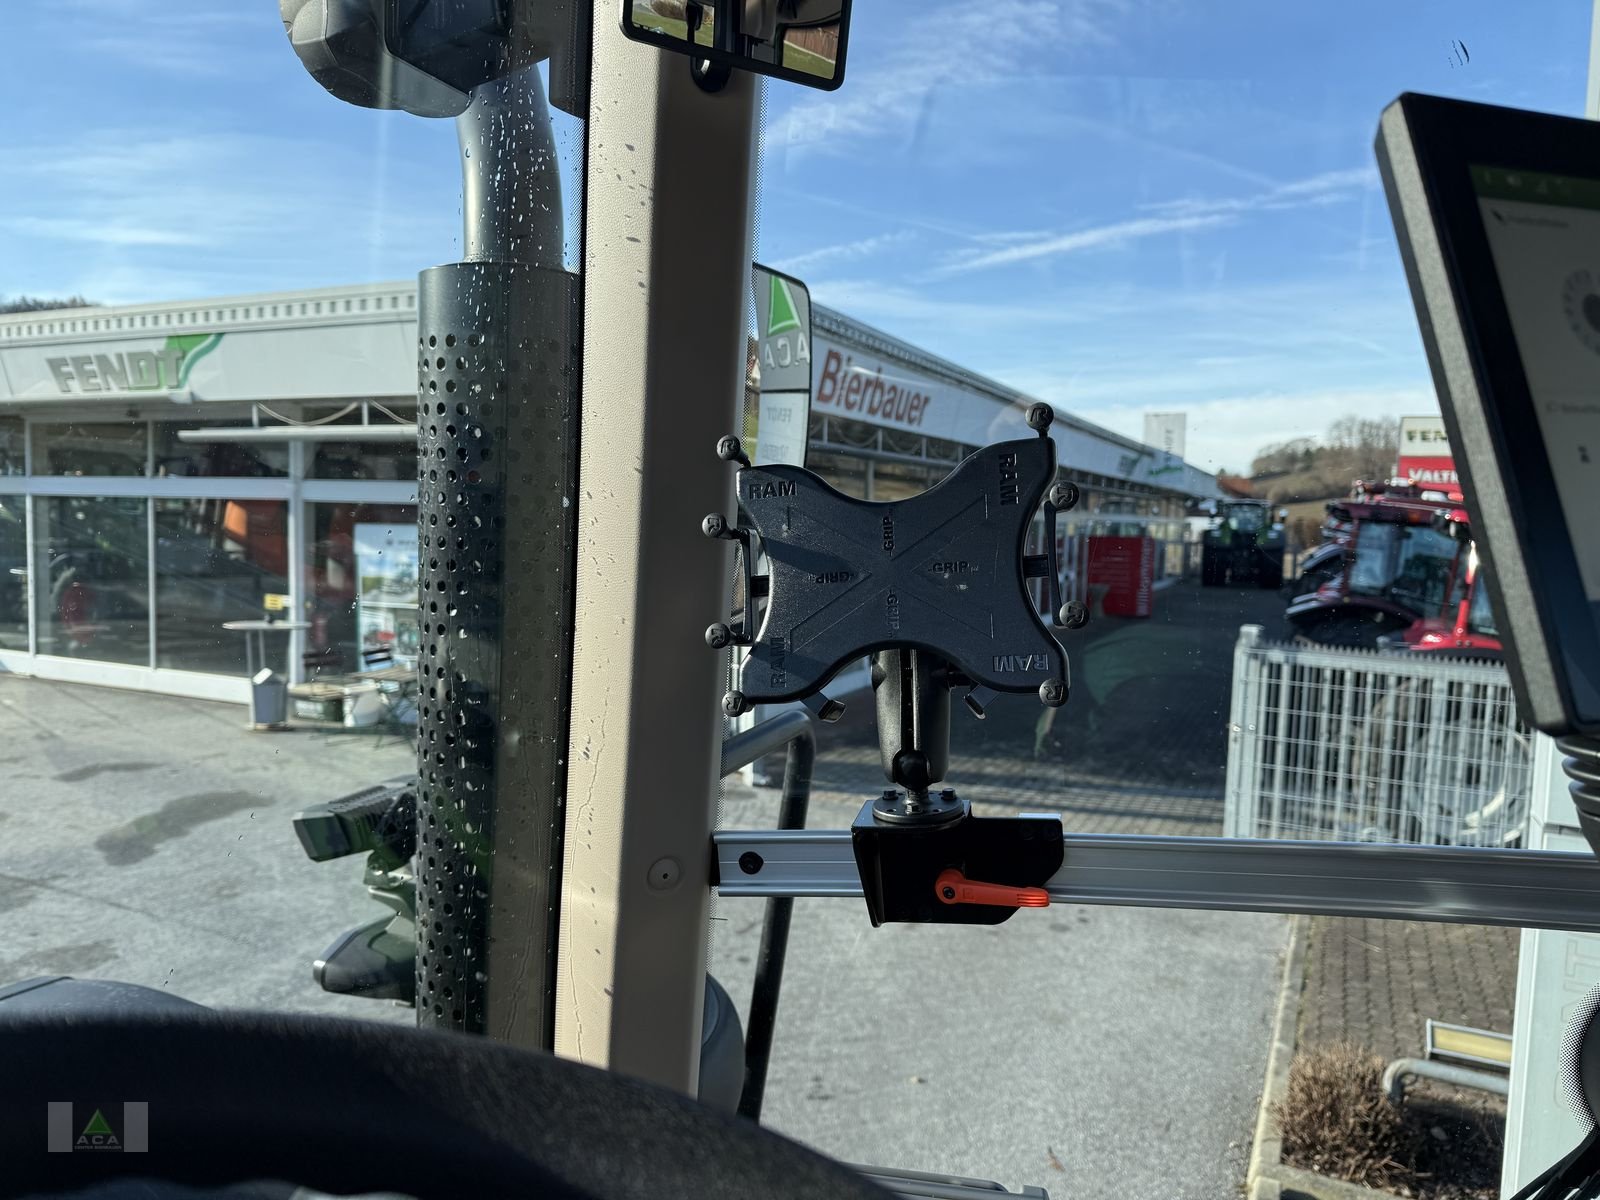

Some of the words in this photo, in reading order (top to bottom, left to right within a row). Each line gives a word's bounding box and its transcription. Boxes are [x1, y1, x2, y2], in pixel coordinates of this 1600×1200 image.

[46, 347, 186, 393] FENDT
[816, 349, 931, 426] Bierbauer
[750, 480, 797, 499] RAM
[998, 452, 1020, 506] RAM
[770, 636, 787, 688] RAM
[993, 653, 1049, 673] RAM
